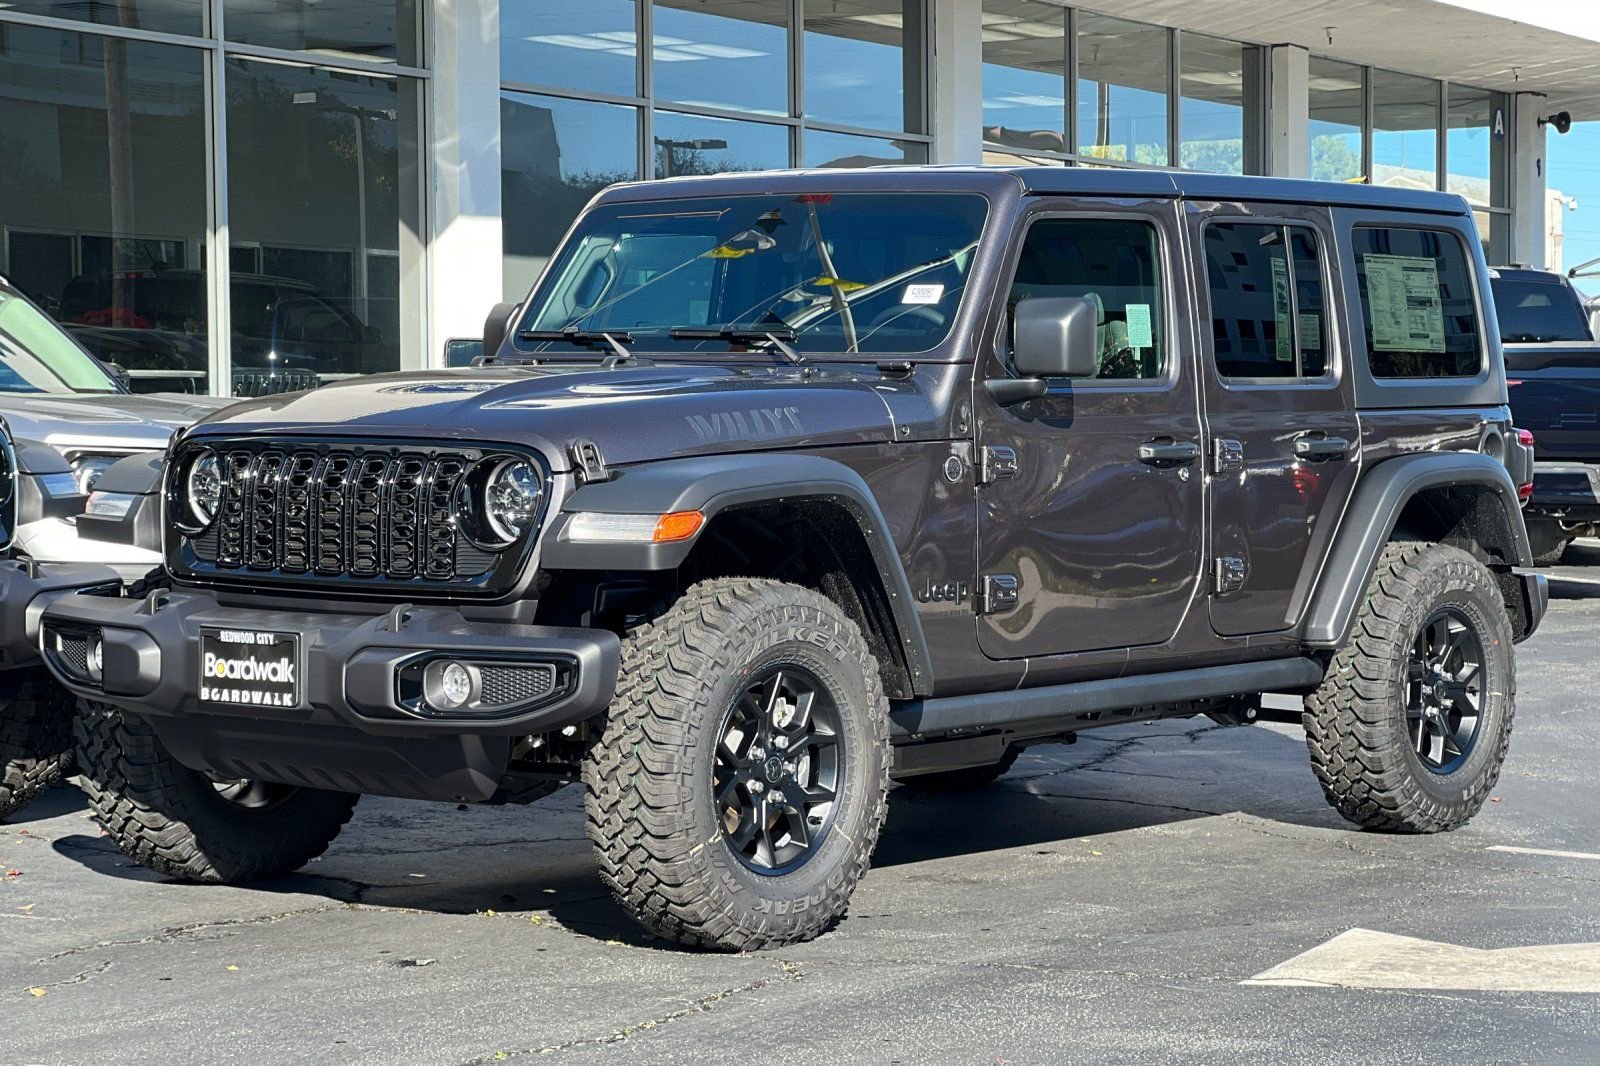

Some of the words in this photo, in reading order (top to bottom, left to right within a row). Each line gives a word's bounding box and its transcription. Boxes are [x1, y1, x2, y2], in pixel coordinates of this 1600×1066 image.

[1494, 109, 1504, 135] A
[684, 406, 804, 441] WILLYS
[918, 577, 967, 606] Jeep
[220, 631, 255, 644] REDWOOD
[256, 633, 275, 645] CITY
[731, 627, 847, 676] FALKEN
[204, 652, 295, 683] Boardwalk
[200, 687, 293, 706] BOARDWALK
